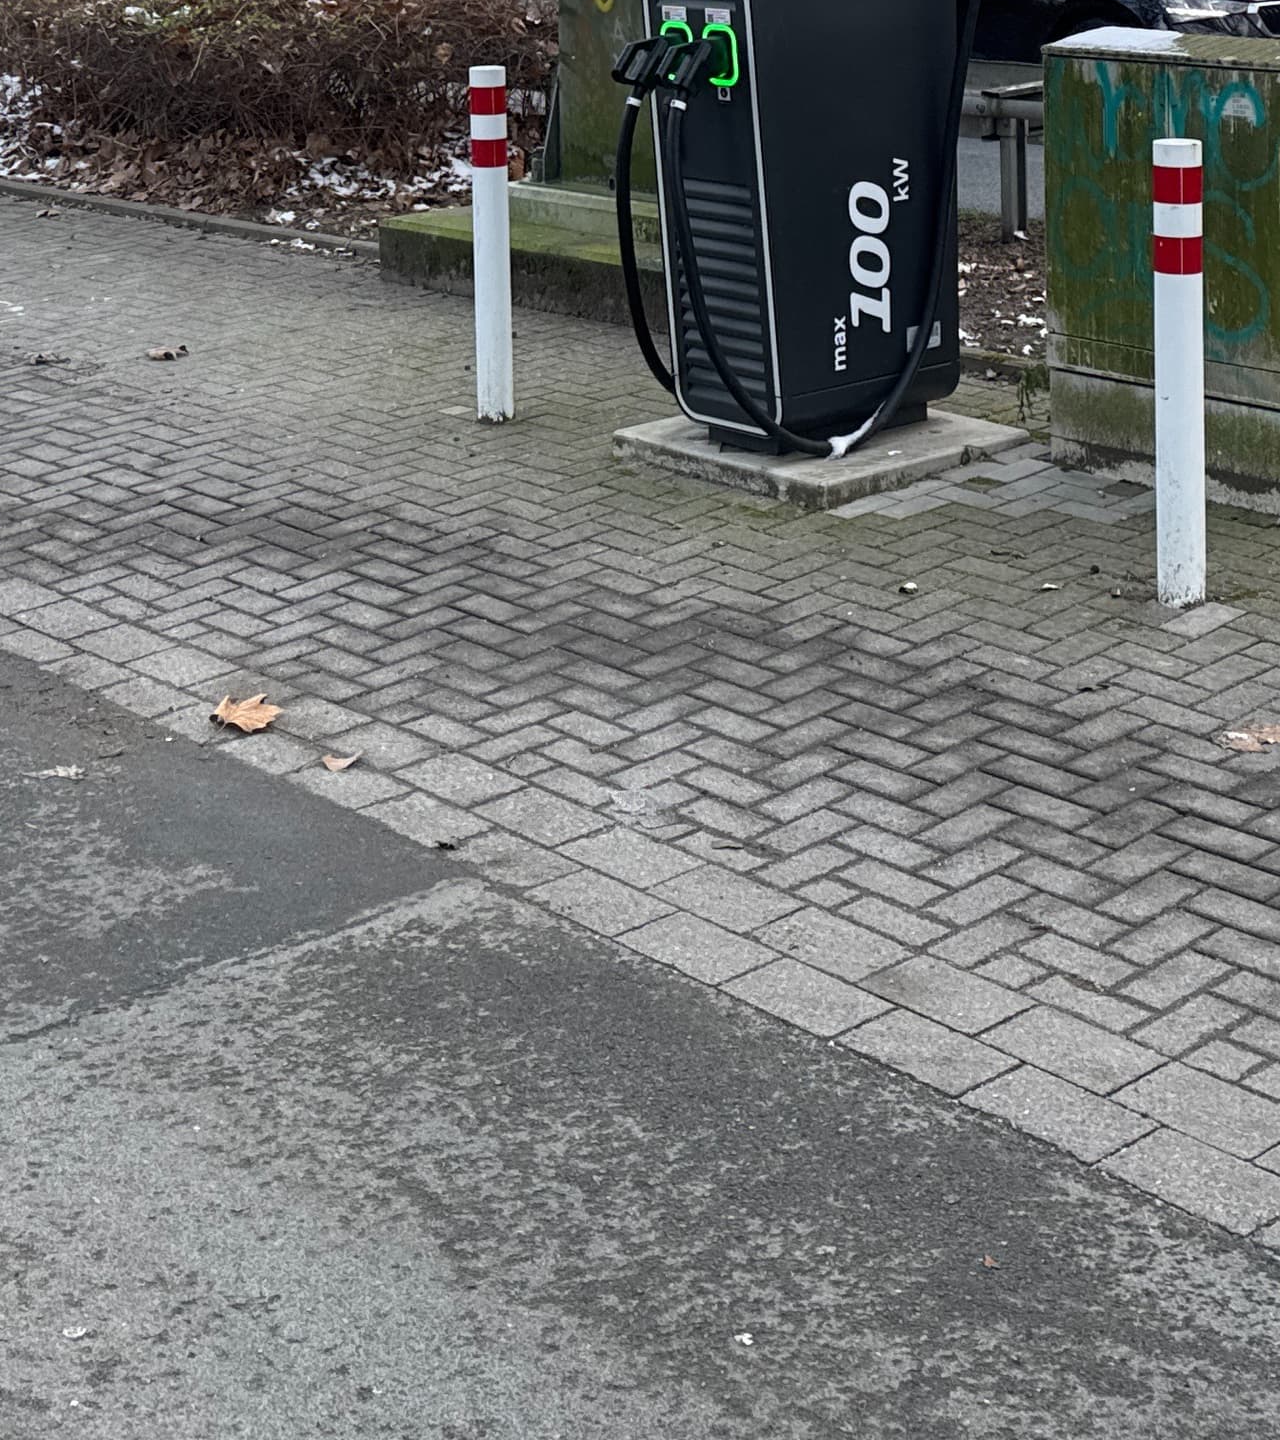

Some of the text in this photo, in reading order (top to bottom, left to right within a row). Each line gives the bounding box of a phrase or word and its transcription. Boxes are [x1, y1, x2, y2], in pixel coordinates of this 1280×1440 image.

[892, 158, 909, 202] kW
[849, 180, 893, 335] 100
[834, 316, 848, 372] max
